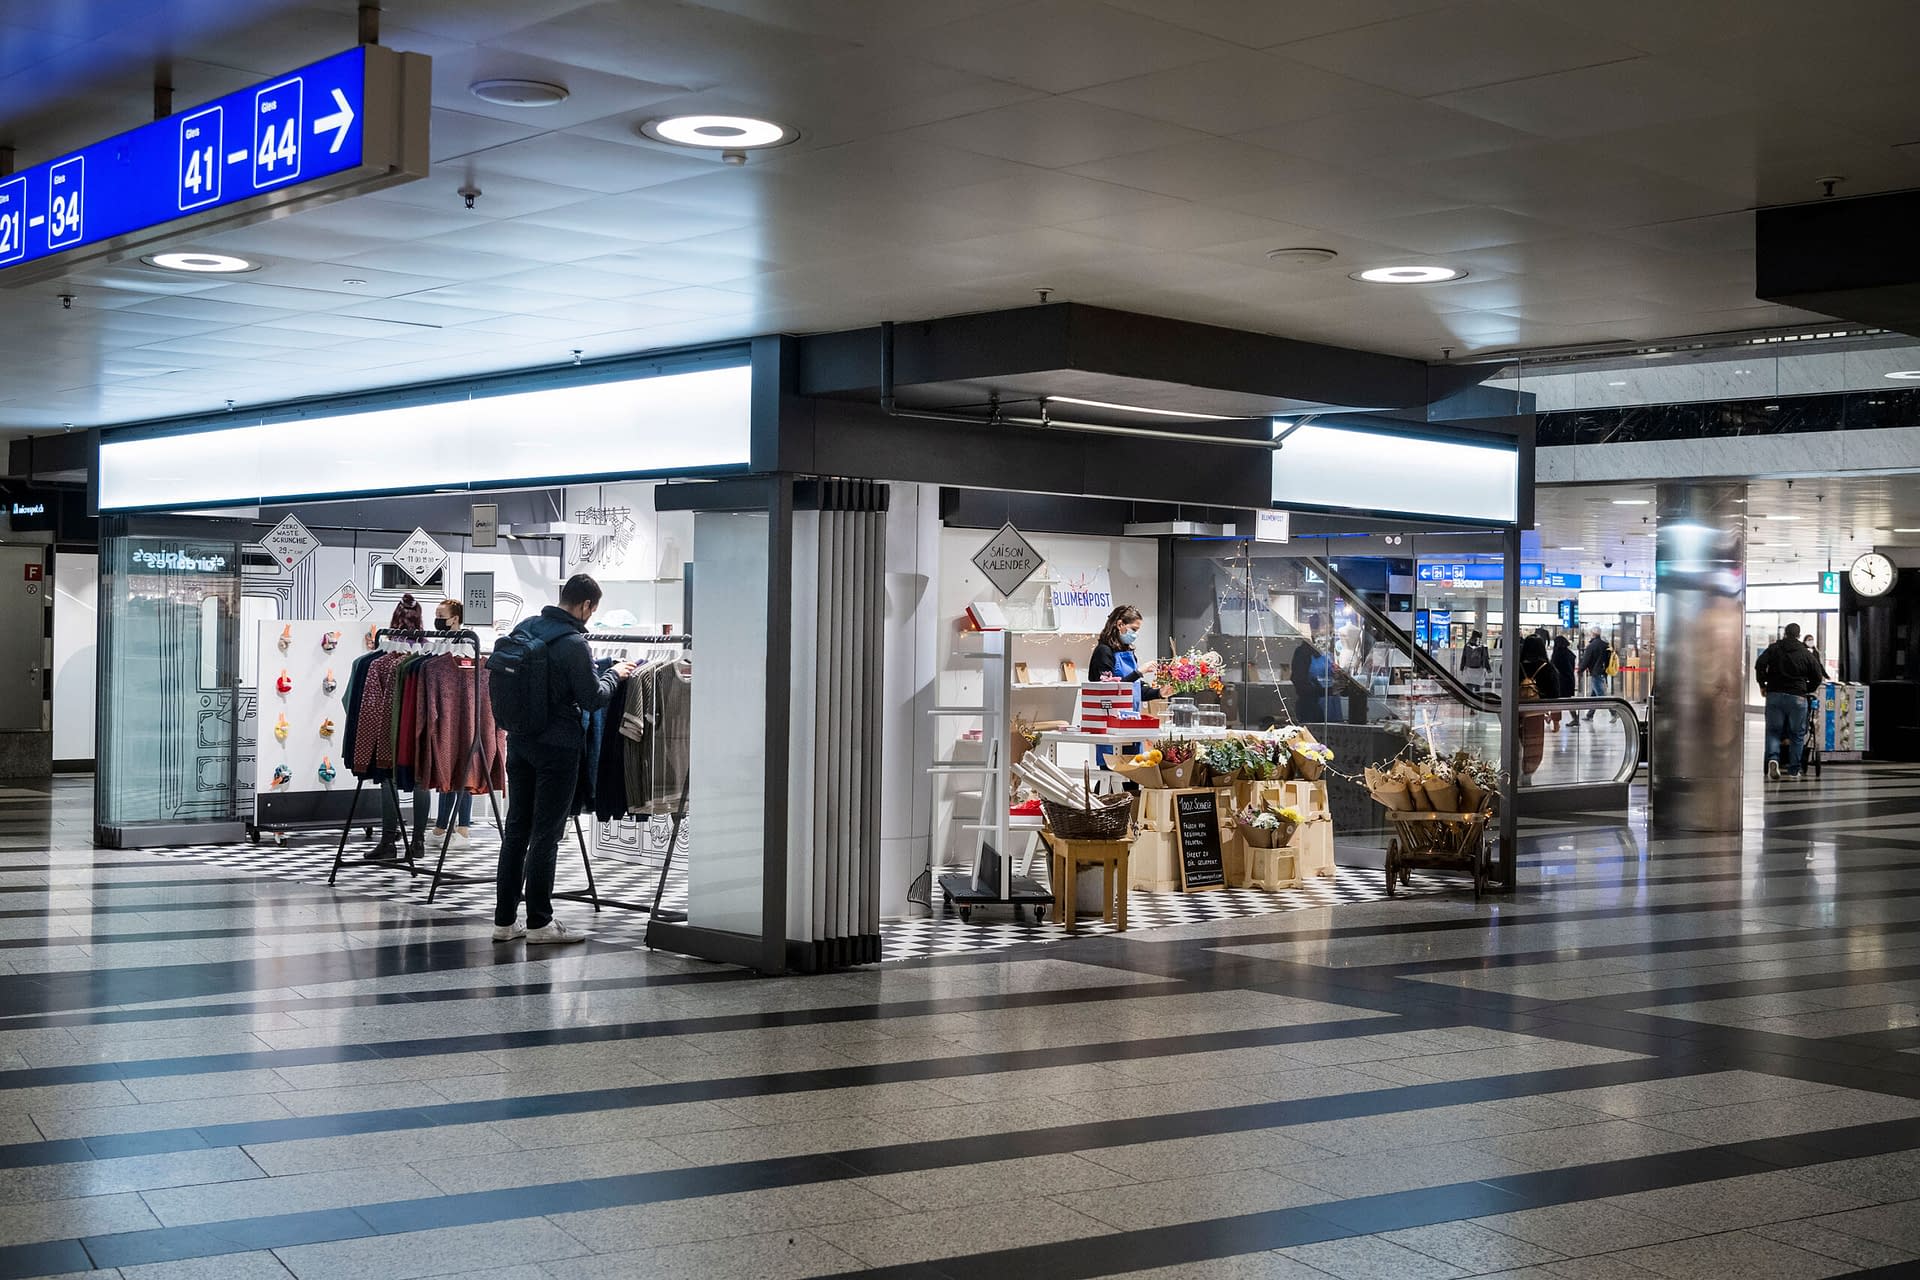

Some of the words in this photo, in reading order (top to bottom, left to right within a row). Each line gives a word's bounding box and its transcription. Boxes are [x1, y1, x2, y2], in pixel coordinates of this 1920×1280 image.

[184, 145, 213, 194] 41
[257, 118, 297, 171] 44
[0, 211, 19, 253] 21
[52, 191, 80, 237] 34
[272, 537, 308, 545] SCRUNCHIE
[982, 558, 1032, 571] KALENDER
[29, 567, 37, 579] F
[1053, 591, 1111, 607] BLUMENPOST
